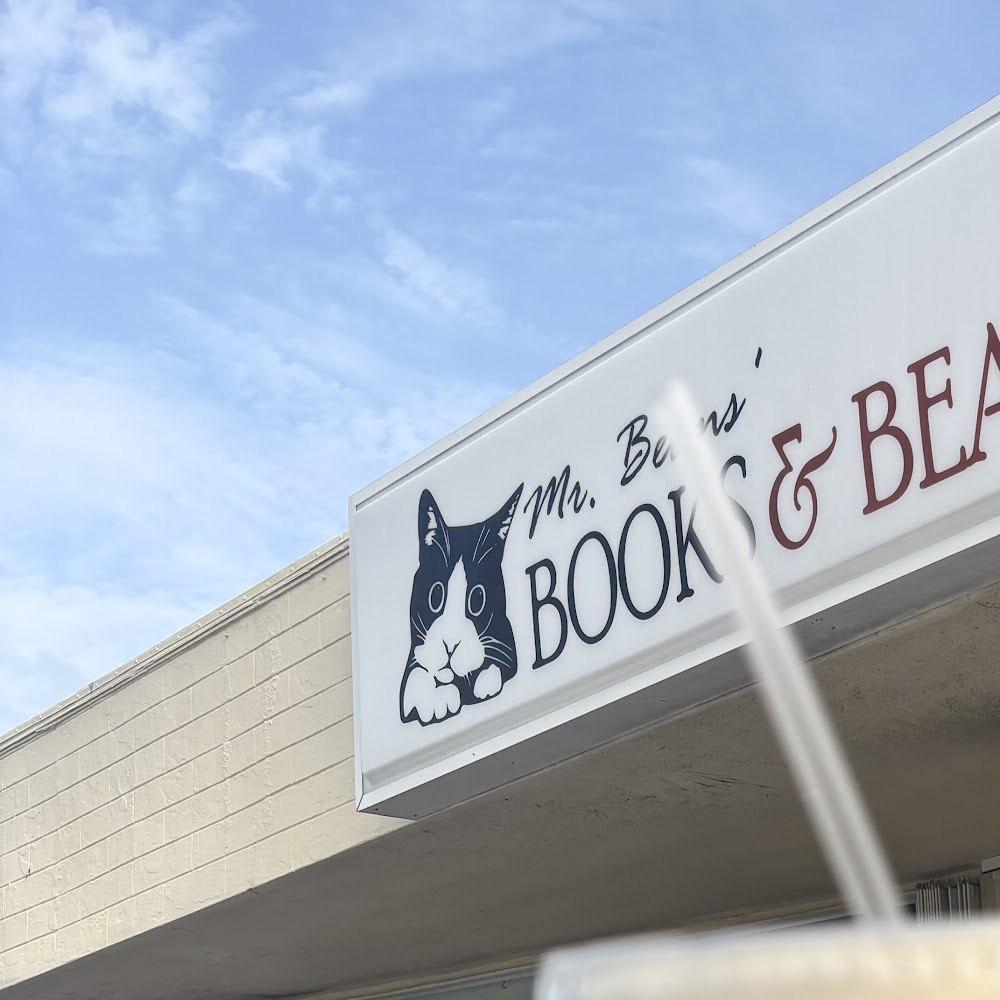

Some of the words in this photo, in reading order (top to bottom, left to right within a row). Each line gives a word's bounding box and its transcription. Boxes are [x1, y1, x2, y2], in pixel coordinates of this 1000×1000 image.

[524, 465, 595, 539] Mr.
[616, 347, 762, 487] Bens'
[769, 422, 837, 550] &
